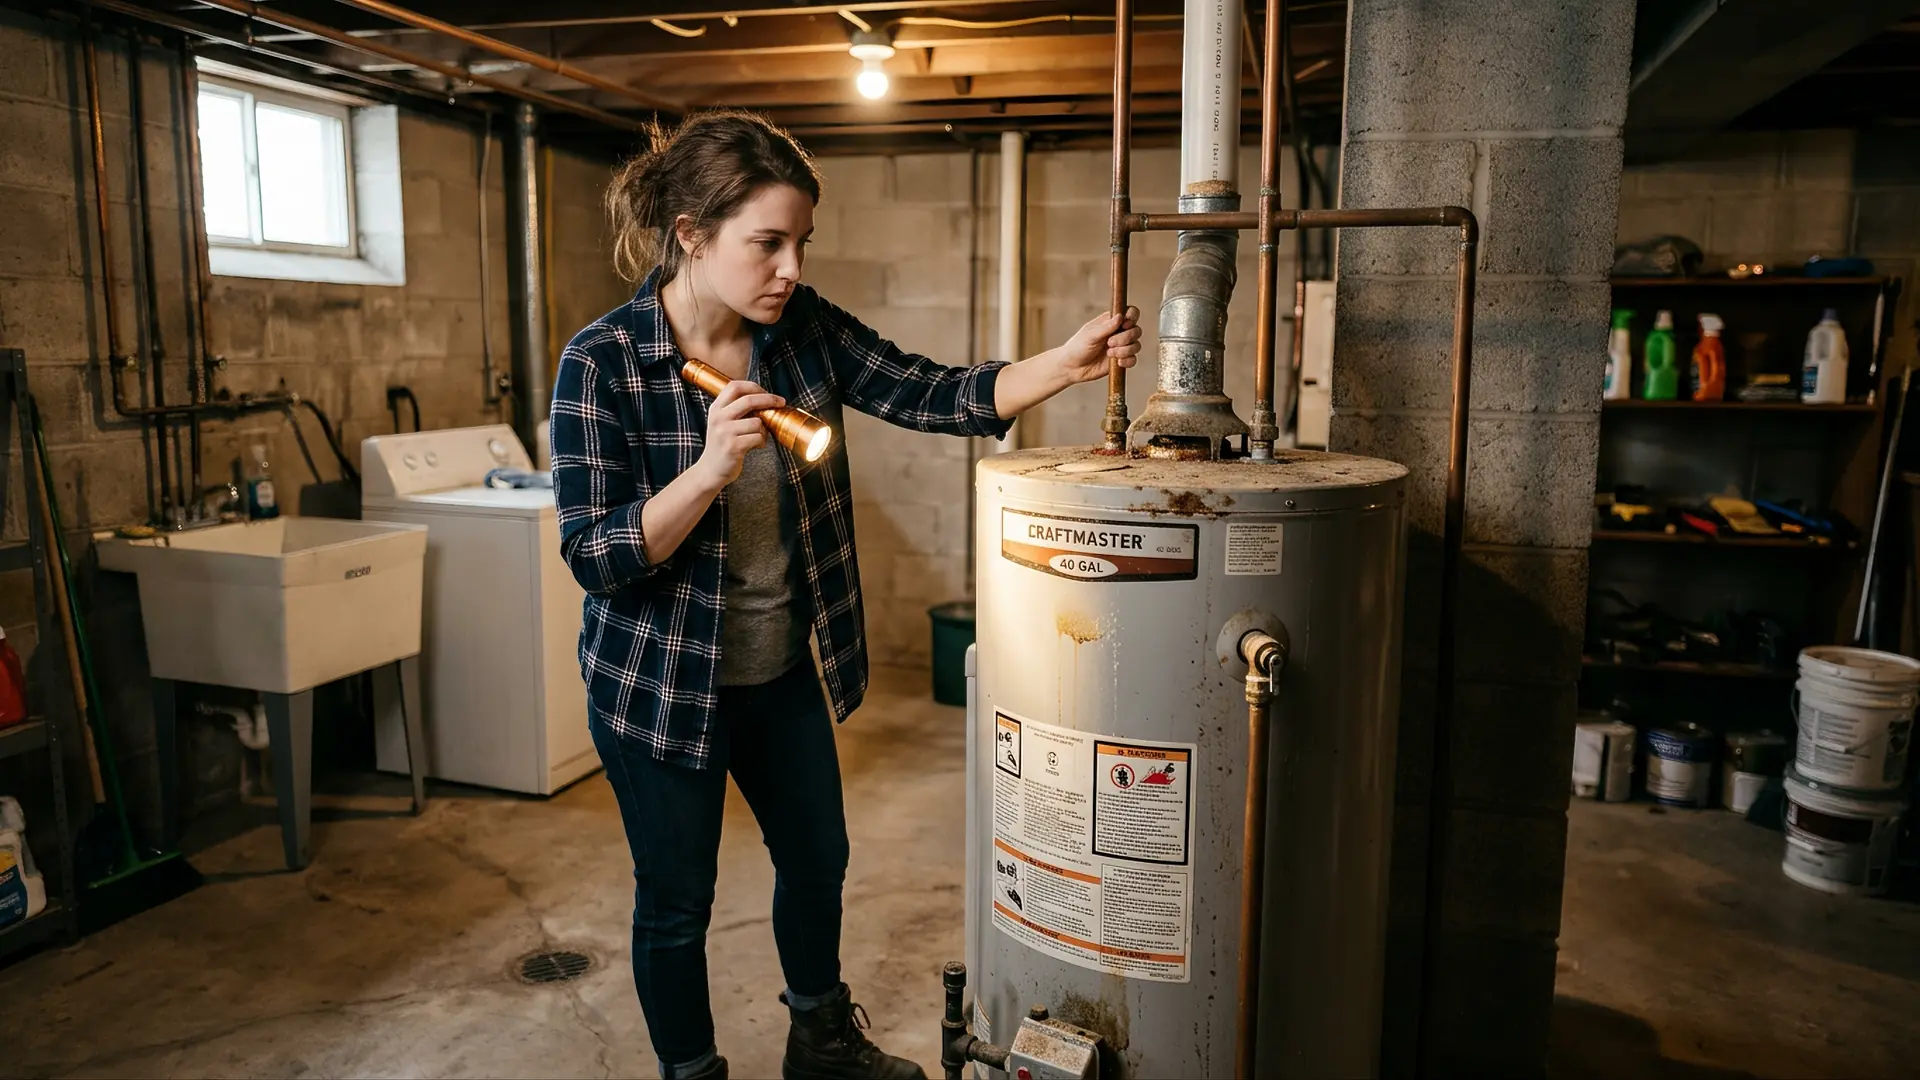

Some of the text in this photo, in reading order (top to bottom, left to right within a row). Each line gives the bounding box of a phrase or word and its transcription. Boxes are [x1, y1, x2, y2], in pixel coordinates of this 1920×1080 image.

[1028, 524, 1143, 549] CRAFTMASTER
[1060, 559, 1103, 573] 40 GAL
